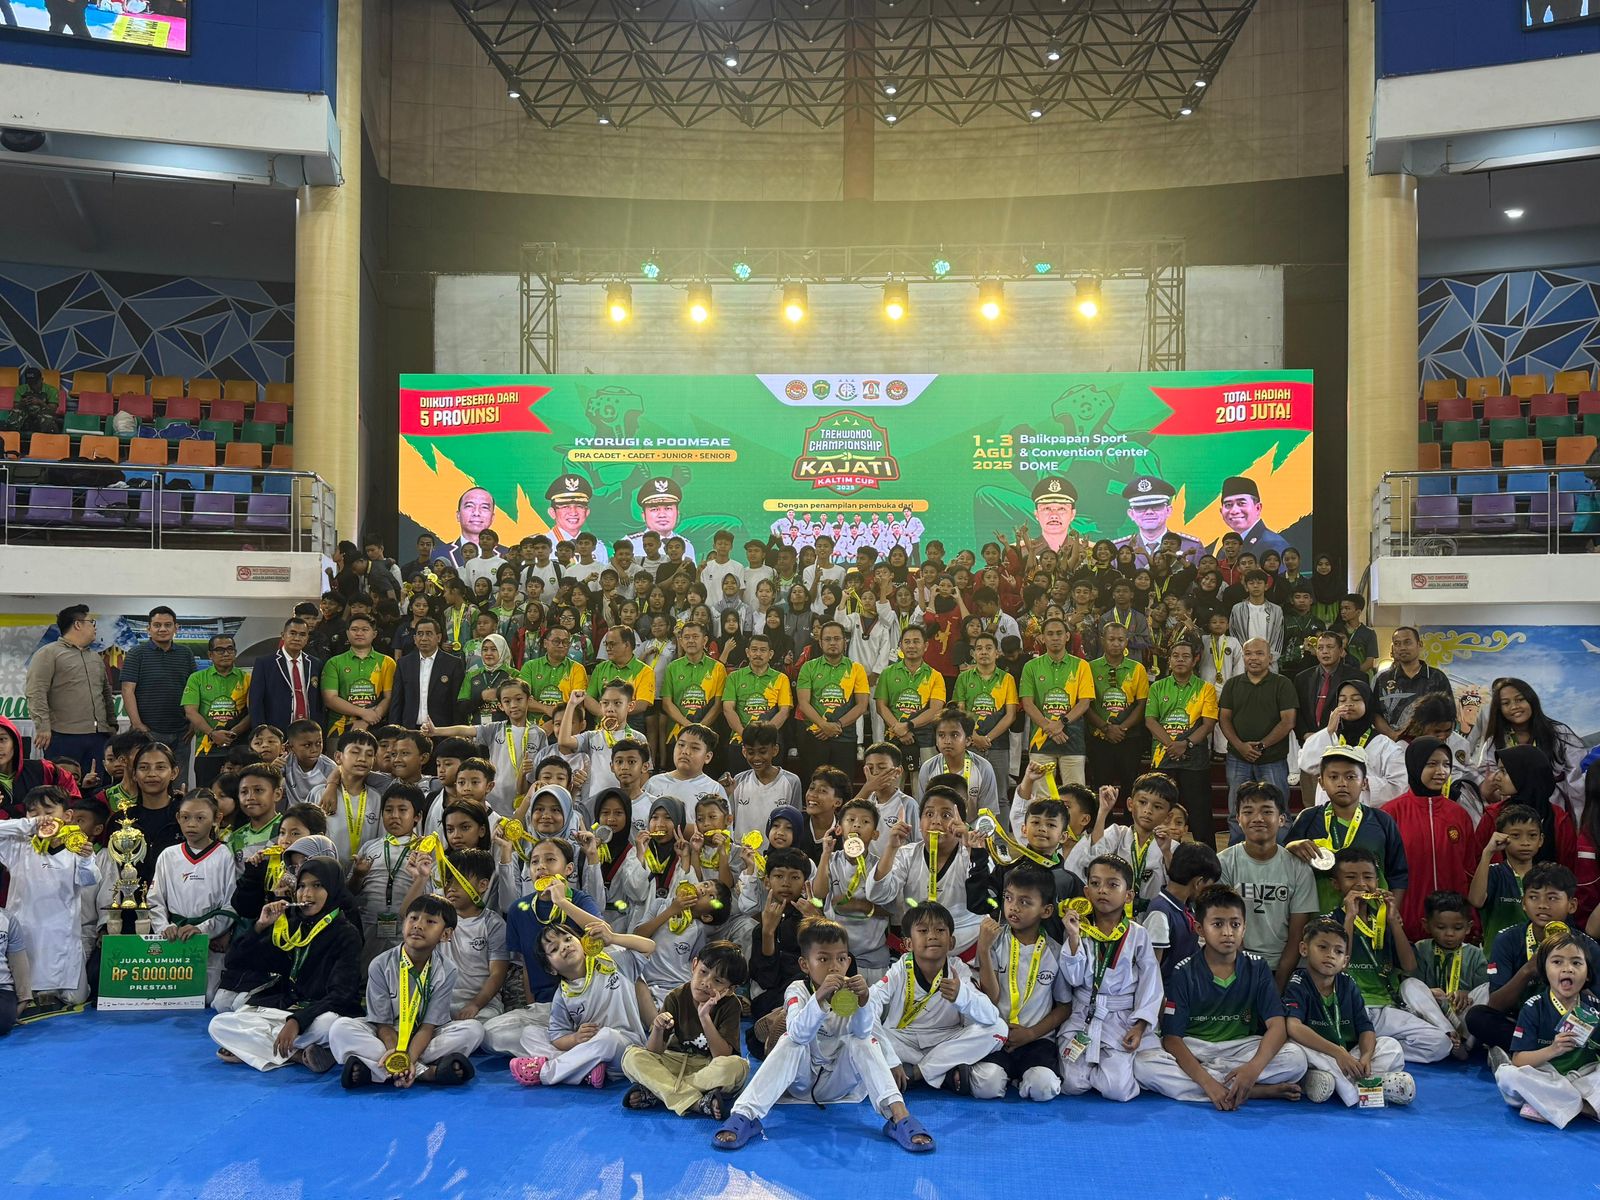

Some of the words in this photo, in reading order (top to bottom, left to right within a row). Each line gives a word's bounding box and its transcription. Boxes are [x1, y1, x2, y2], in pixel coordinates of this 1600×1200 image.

[420, 396, 453, 408] DIIKUTI
[455, 393, 495, 406] PESERTA
[497, 392, 519, 403] DARI
[1223, 391, 1252, 403] TOTAL
[1254, 389, 1291, 400] HADIAH
[420, 410, 430, 426] 5
[433, 406, 500, 426] PROVINSI
[1215, 404, 1246, 423] 200
[1250, 403, 1291, 420] JUTA!
[820, 429, 872, 439] TAEKWONDO
[1020, 434, 1090, 445] Balikpapan
[1093, 434, 1127, 444] Sport
[574, 437, 640, 446] KYORUGI
[643, 437, 654, 446] &
[657, 437, 730, 446] POOMSAE
[809, 440, 882, 451] CHAMPIONSHIP
[973, 435, 981, 446] 1
[1000, 434, 1013, 446] 3
[973, 448, 1013, 458] AGU
[1020, 448, 1028, 457] &
[1031, 447, 1102, 457] Convention
[1106, 448, 1149, 457] Center
[800, 461, 892, 476] KAJATI
[973, 461, 1013, 470] 2025
[1020, 461, 1059, 471] DOME
[818, 477, 852, 485] KALTIM
[855, 477, 874, 485] CUP
[1238, 883, 1289, 901] ENZO
[112, 966, 128, 981] Rp
[132, 966, 193, 980] 5.000.000
